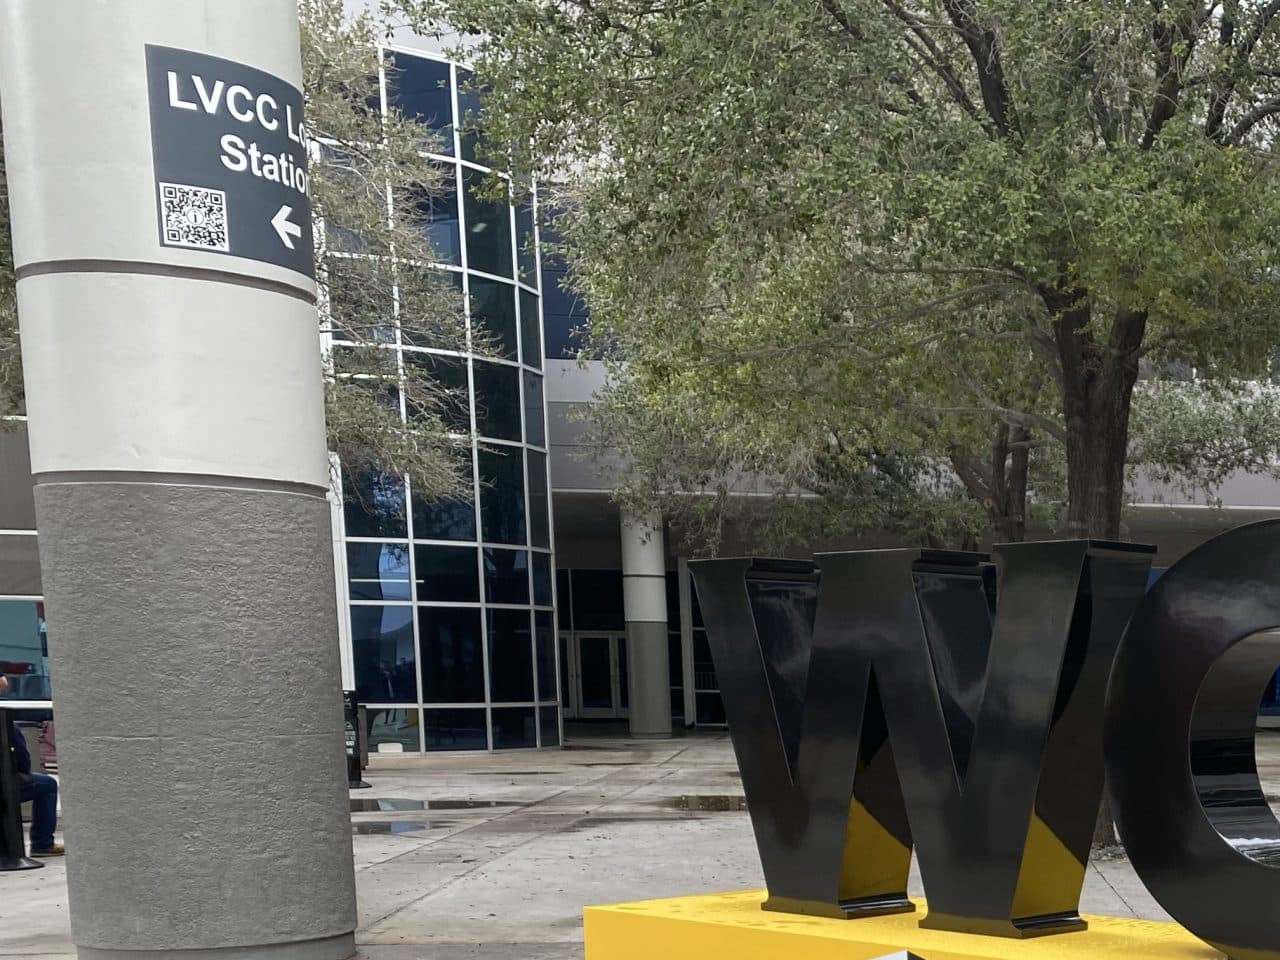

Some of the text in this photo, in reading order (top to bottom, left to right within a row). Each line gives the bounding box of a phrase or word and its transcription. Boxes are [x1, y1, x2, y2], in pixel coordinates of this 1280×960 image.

[167, 71, 306, 149] LVCC Lo
[220, 134, 309, 198] Statio
